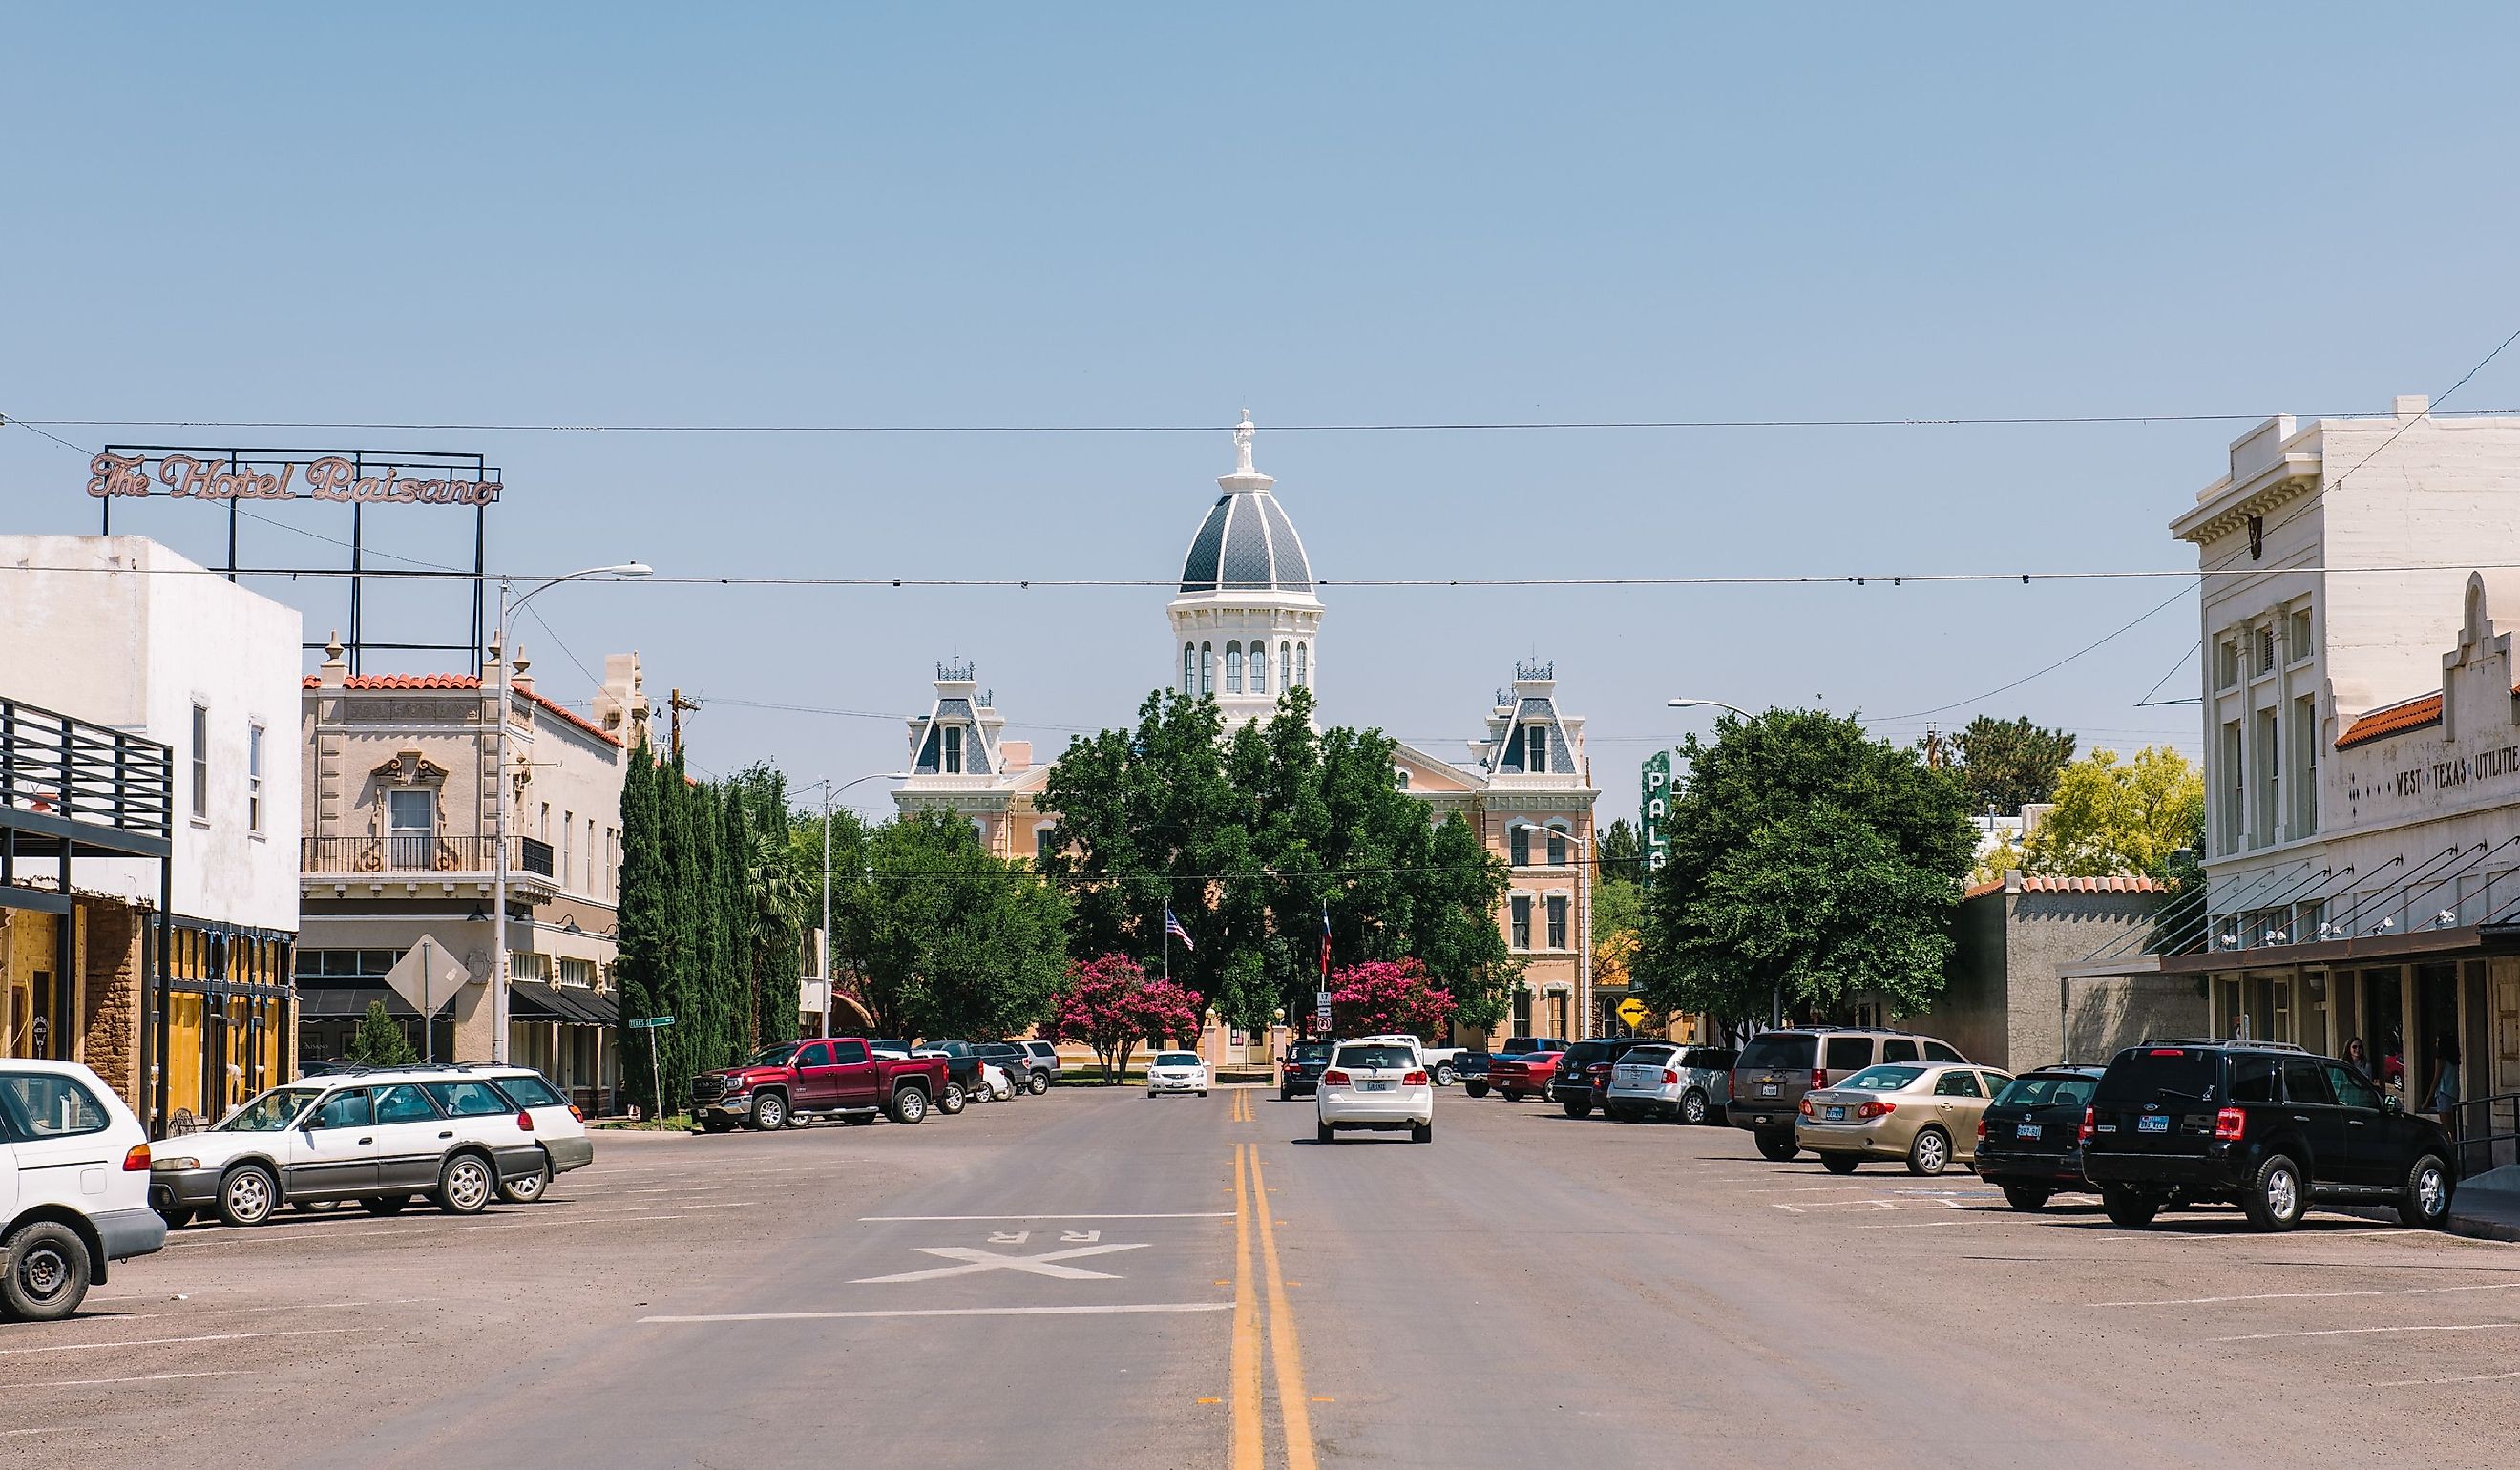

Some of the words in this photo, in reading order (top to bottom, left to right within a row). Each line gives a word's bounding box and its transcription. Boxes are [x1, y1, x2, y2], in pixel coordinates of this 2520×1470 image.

[87, 452, 150, 498] The
[158, 454, 297, 500] Hotel
[305, 456, 504, 506] Paisano
[2396, 768, 2421, 797] WEST
[2433, 757, 2467, 790] TEXAS
[2475, 745, 2520, 781] UTILITIE
